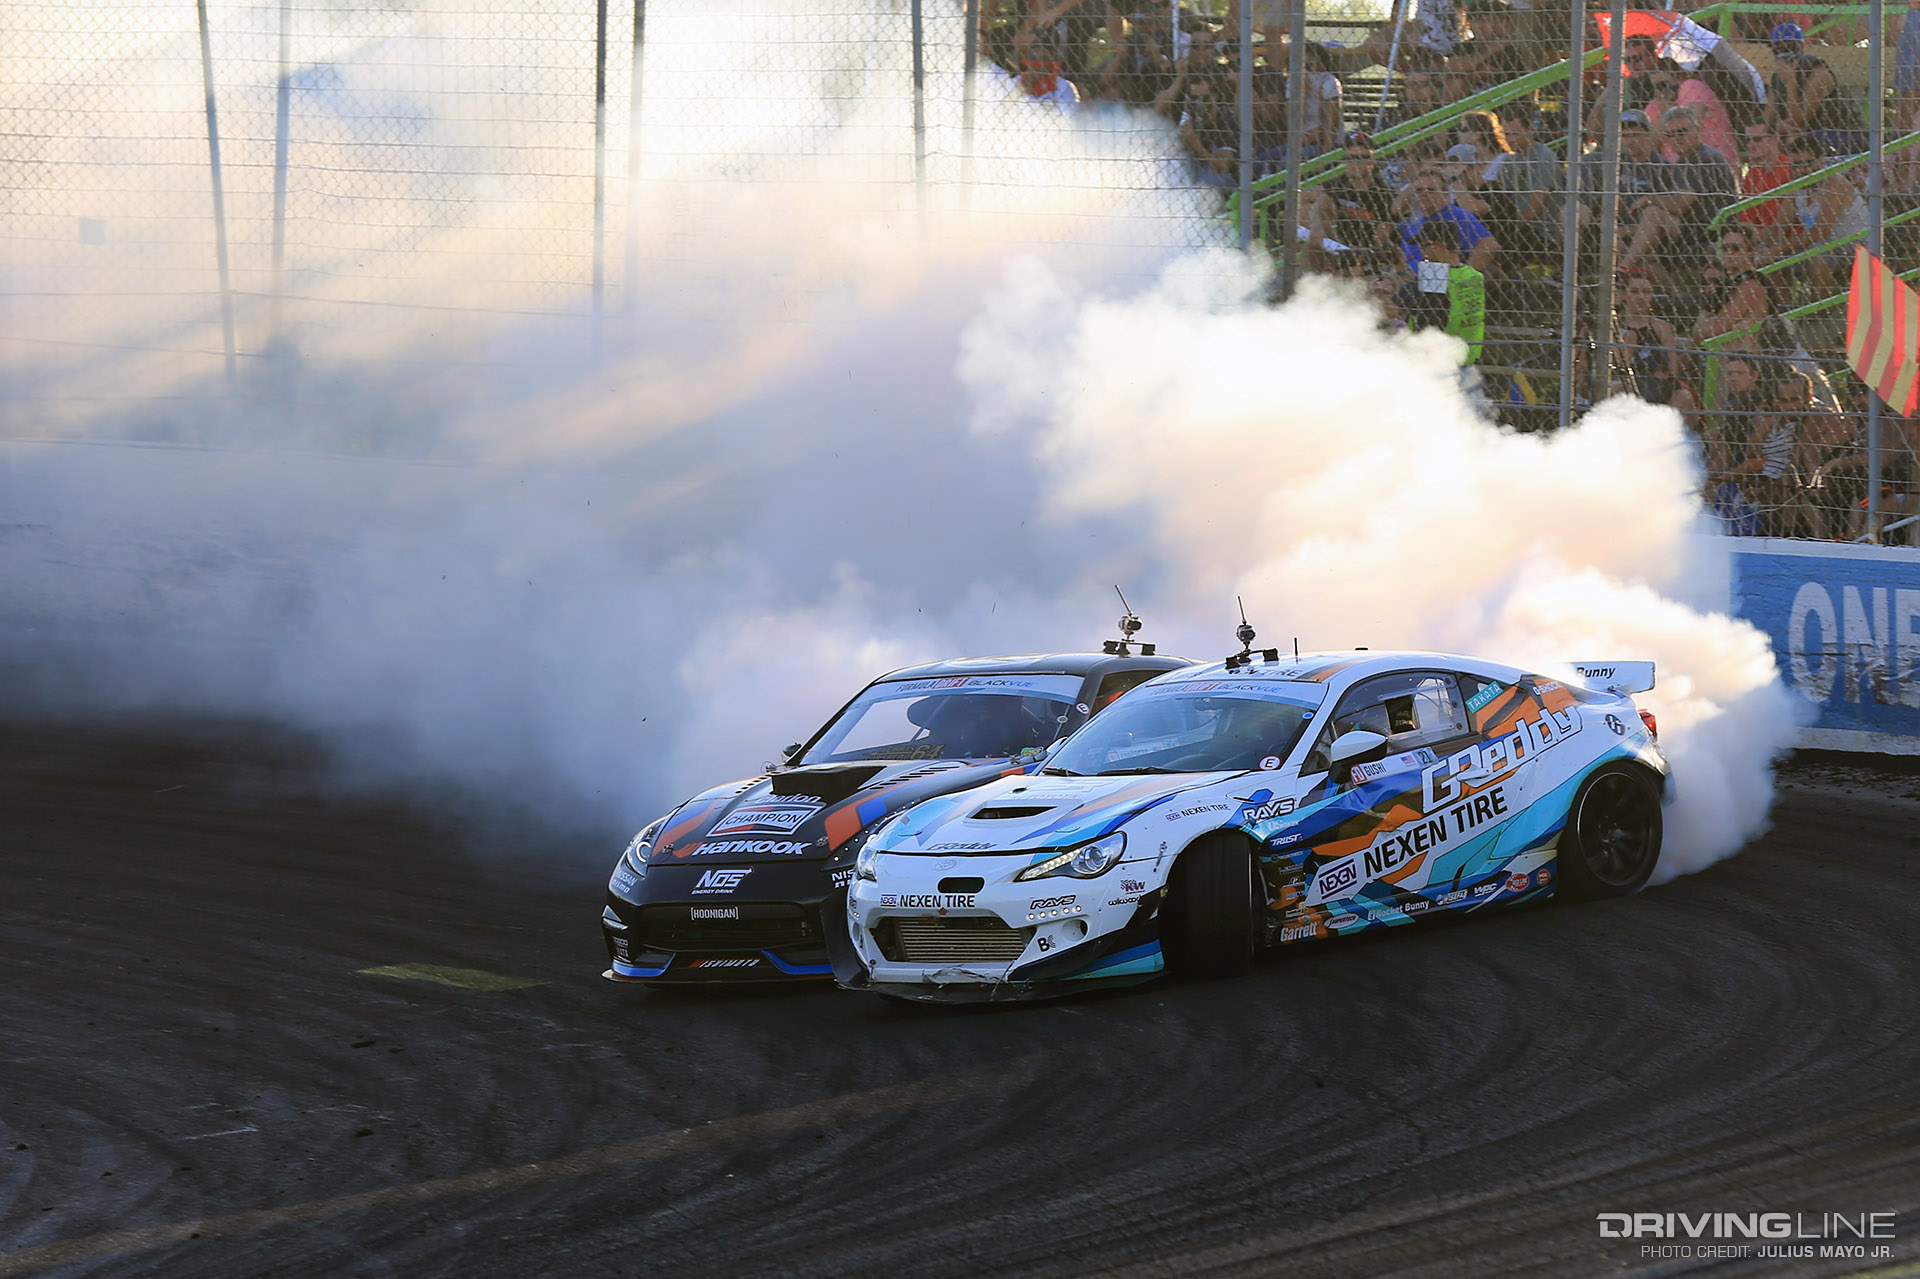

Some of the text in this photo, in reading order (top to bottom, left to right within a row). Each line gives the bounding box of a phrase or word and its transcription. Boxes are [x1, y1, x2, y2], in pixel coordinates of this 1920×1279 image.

[1576, 667, 1616, 679] Bunny
[1468, 683, 1501, 712] TAKATA
[1265, 757, 1275, 768] E
[1364, 761, 1387, 777] GUSHI
[1181, 805, 1209, 817] NEXEN
[1211, 803, 1231, 812] TIRE
[1243, 798, 1295, 822] RAYS
[726, 812, 802, 825] CHAMPION
[1270, 833, 1302, 847] TRUST
[1363, 786, 1508, 879] NEXEN TIRE
[696, 869, 752, 888] NOS
[900, 894, 941, 908] NEXEN
[945, 894, 976, 908] TIRE
[1030, 895, 1077, 910] RAYS
[1375, 899, 1430, 919] Rocket Bunny
[1280, 921, 1318, 942] Garrett
